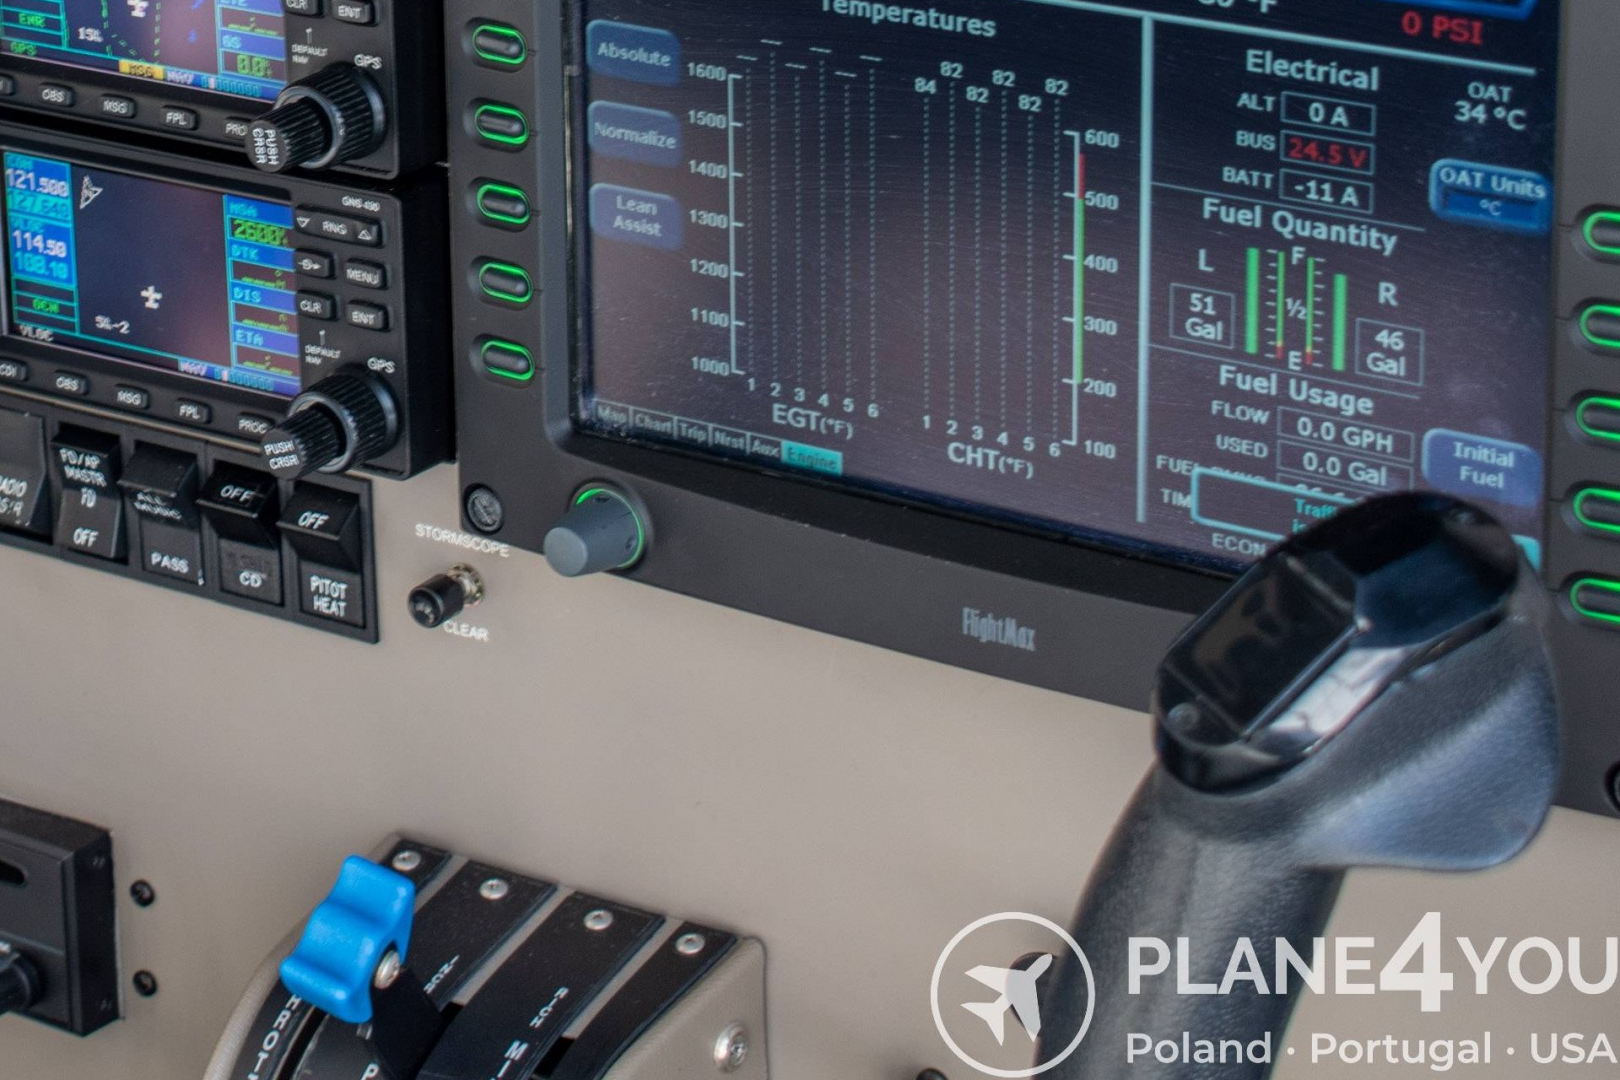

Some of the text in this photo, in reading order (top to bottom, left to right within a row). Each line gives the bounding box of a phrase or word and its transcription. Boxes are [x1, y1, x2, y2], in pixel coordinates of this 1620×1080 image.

[338, 6, 362, 19] ENT
[1401, 11, 1484, 45] 0 PSI
[354, 54, 382, 70] GPS
[597, 42, 672, 67] Absolute
[687, 62, 727, 81] 1600
[1246, 49, 1379, 91] Electrical
[1467, 82, 1513, 103] OAT
[103, 99, 127, 114] MSG
[1237, 94, 1349, 127] ALT 0 A
[1454, 101, 1527, 130] 34 °C
[166, 111, 187, 125] FPL
[688, 110, 727, 129] 1500
[593, 122, 676, 150] Normalize
[1084, 129, 1120, 148] 600
[1236, 131, 1366, 168] BUS 24.5 V
[688, 160, 728, 179] 1400
[5, 168, 69, 197] 121.500
[1223, 167, 1359, 207] BATT -11 A
[1440, 168, 1546, 198] OAT Units
[616, 195, 657, 216] Lean
[1084, 192, 1119, 210] 500
[322, 221, 347, 235] RNG
[613, 214, 662, 237] Assist
[689, 209, 729, 229] 1300
[1203, 198, 1397, 256] Fuel Quantity
[13, 229, 67, 258] 114.50
[346, 268, 379, 285] MENU
[690, 259, 729, 279] 1200
[300, 300, 322, 314] CLR
[1190, 293, 1216, 315] 51
[352, 311, 376, 325] ENT
[691, 308, 730, 327] 1100
[1084, 317, 1118, 335] 300
[1185, 317, 1223, 342] Gal
[1374, 330, 1405, 351] 46
[367, 357, 395, 374] GPS
[691, 356, 730, 377] 1000
[1366, 352, 1406, 378] Gal
[56, 375, 79, 392] OBS
[1219, 365, 1374, 417] Fuel Usage
[116, 389, 141, 406] MSG
[179, 403, 200, 420] FPL
[1211, 400, 1393, 454] FLOW 0.0 GPH
[264, 439, 294, 455] PUSH
[1454, 440, 1515, 468] Initial
[1216, 434, 1388, 487] USED 0.0 Gal
[1460, 464, 1504, 489] Fuel
[219, 484, 257, 504] OFF
[298, 510, 329, 530] OFF
[73, 527, 98, 548] OFF
[415, 523, 510, 558] STORMSCOPE
[150, 551, 189, 574] PASS
[239, 570, 263, 588] CD
[310, 575, 348, 599] PITOT
[313, 595, 348, 618] HEAT
[443, 619, 490, 642] CLEAR
[530, 986, 569, 1028] RICH
